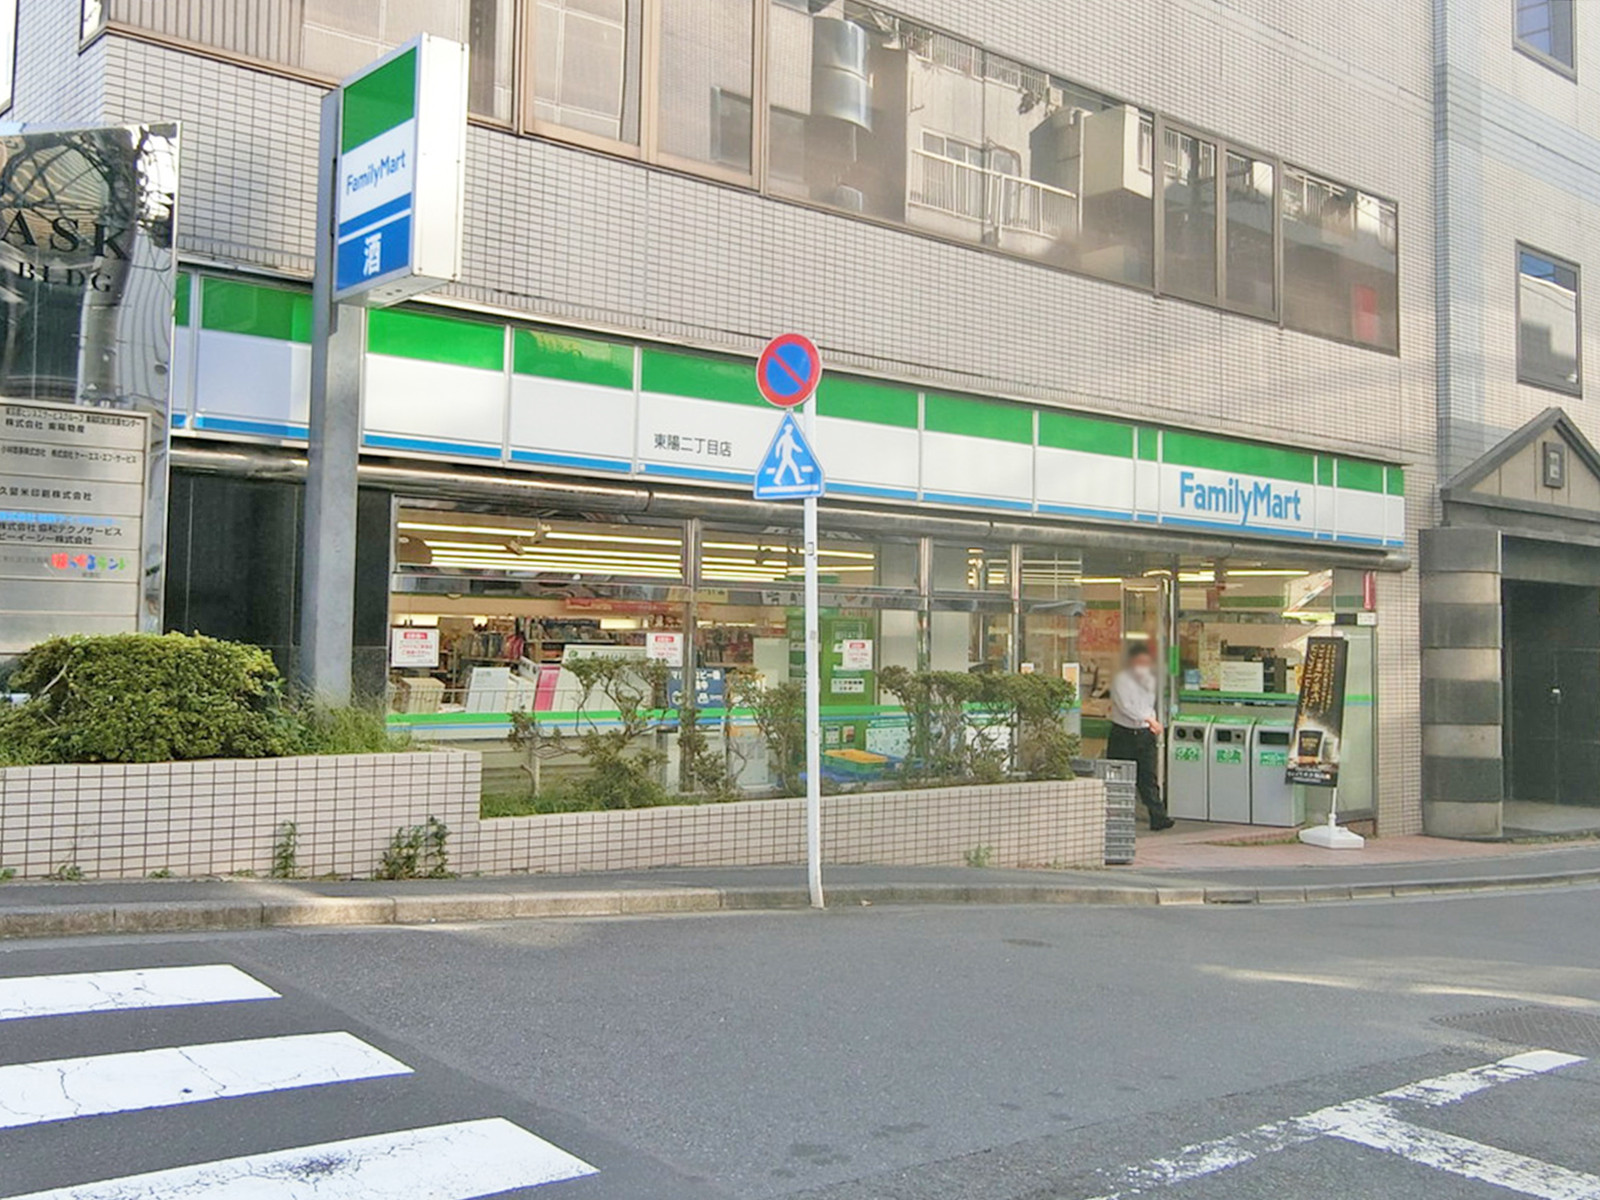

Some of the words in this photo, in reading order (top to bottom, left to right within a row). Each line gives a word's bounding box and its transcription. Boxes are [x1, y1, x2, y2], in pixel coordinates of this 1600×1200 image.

[346, 150, 406, 195] FamilyMart
[0, 210, 132, 261] ASK
[363, 232, 382, 276] 酒
[19, 262, 112, 293] BLDG
[654, 433, 732, 457] 東陽二丁目店
[1180, 471, 1301, 525] FamilyMart
